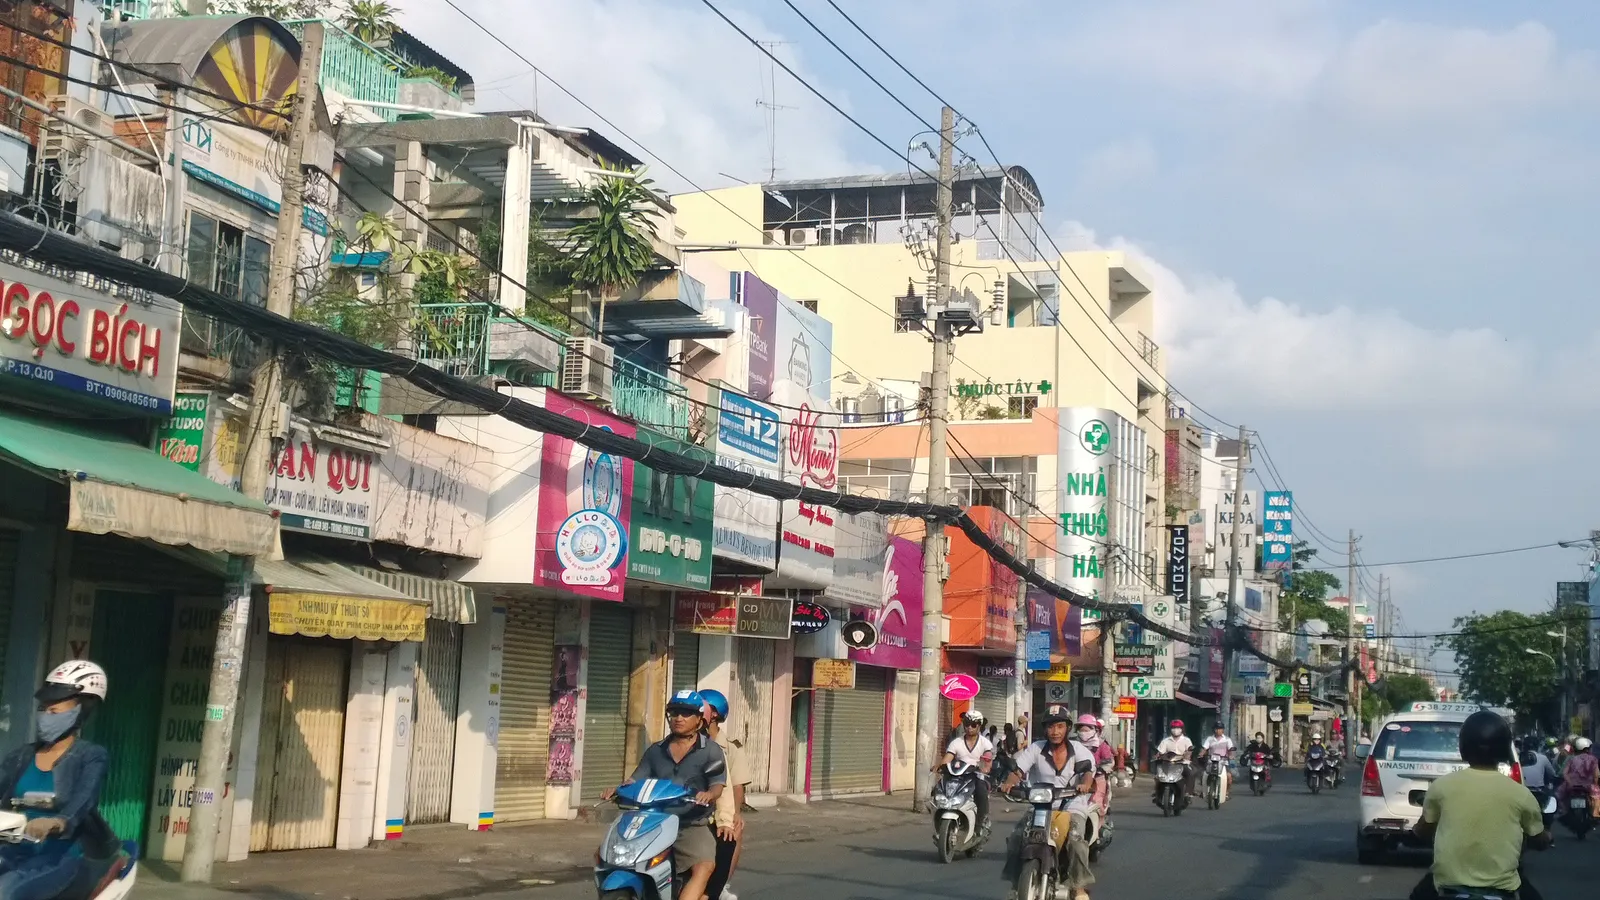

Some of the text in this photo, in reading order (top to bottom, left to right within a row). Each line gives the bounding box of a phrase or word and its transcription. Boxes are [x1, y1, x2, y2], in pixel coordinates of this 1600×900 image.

[86, 302, 161, 378] BÍCH
[105, 386, 158, 408] 0909485610
[1005, 378, 1033, 394] TÂY
[175, 397, 206, 411] HOTO
[161, 417, 204, 430] STUDIO
[744, 406, 777, 447] H2
[269, 441, 319, 483] AN
[1066, 467, 1107, 497] NHÀ
[561, 514, 599, 538] HELLO
[1060, 503, 1109, 537] THUỐ
[715, 527, 740, 549] ALWAYS
[1220, 533, 1252, 548] VIT
[1172, 527, 1185, 601] TONYMOLY
[743, 604, 758, 614] CD
[740, 620, 759, 632] DVD
[980, 666, 1014, 677] TPBank
[1427, 702, 1452, 711] 38.27
[184, 758, 199, 778] TH
[159, 814, 190, 838] 10 phú
